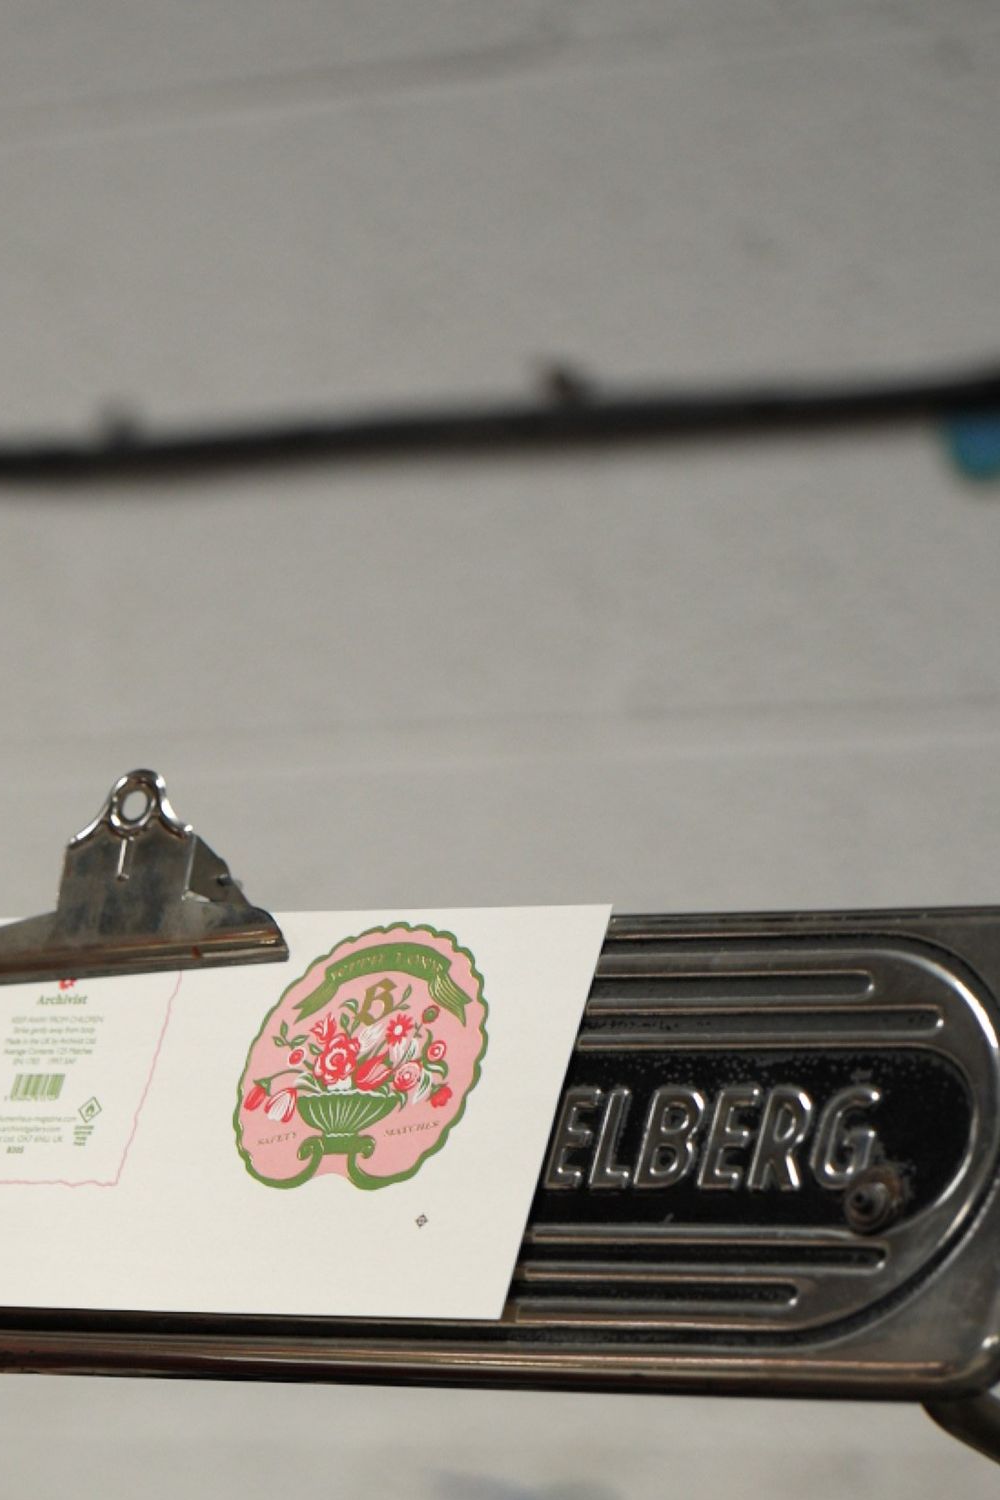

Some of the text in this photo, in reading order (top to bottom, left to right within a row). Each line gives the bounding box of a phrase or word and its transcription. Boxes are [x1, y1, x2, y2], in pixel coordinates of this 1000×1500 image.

[36, 994, 88, 1005] Archivist
[384, 1120, 441, 1136] MATCHES
[543, 1085, 881, 1190] ELBERG
